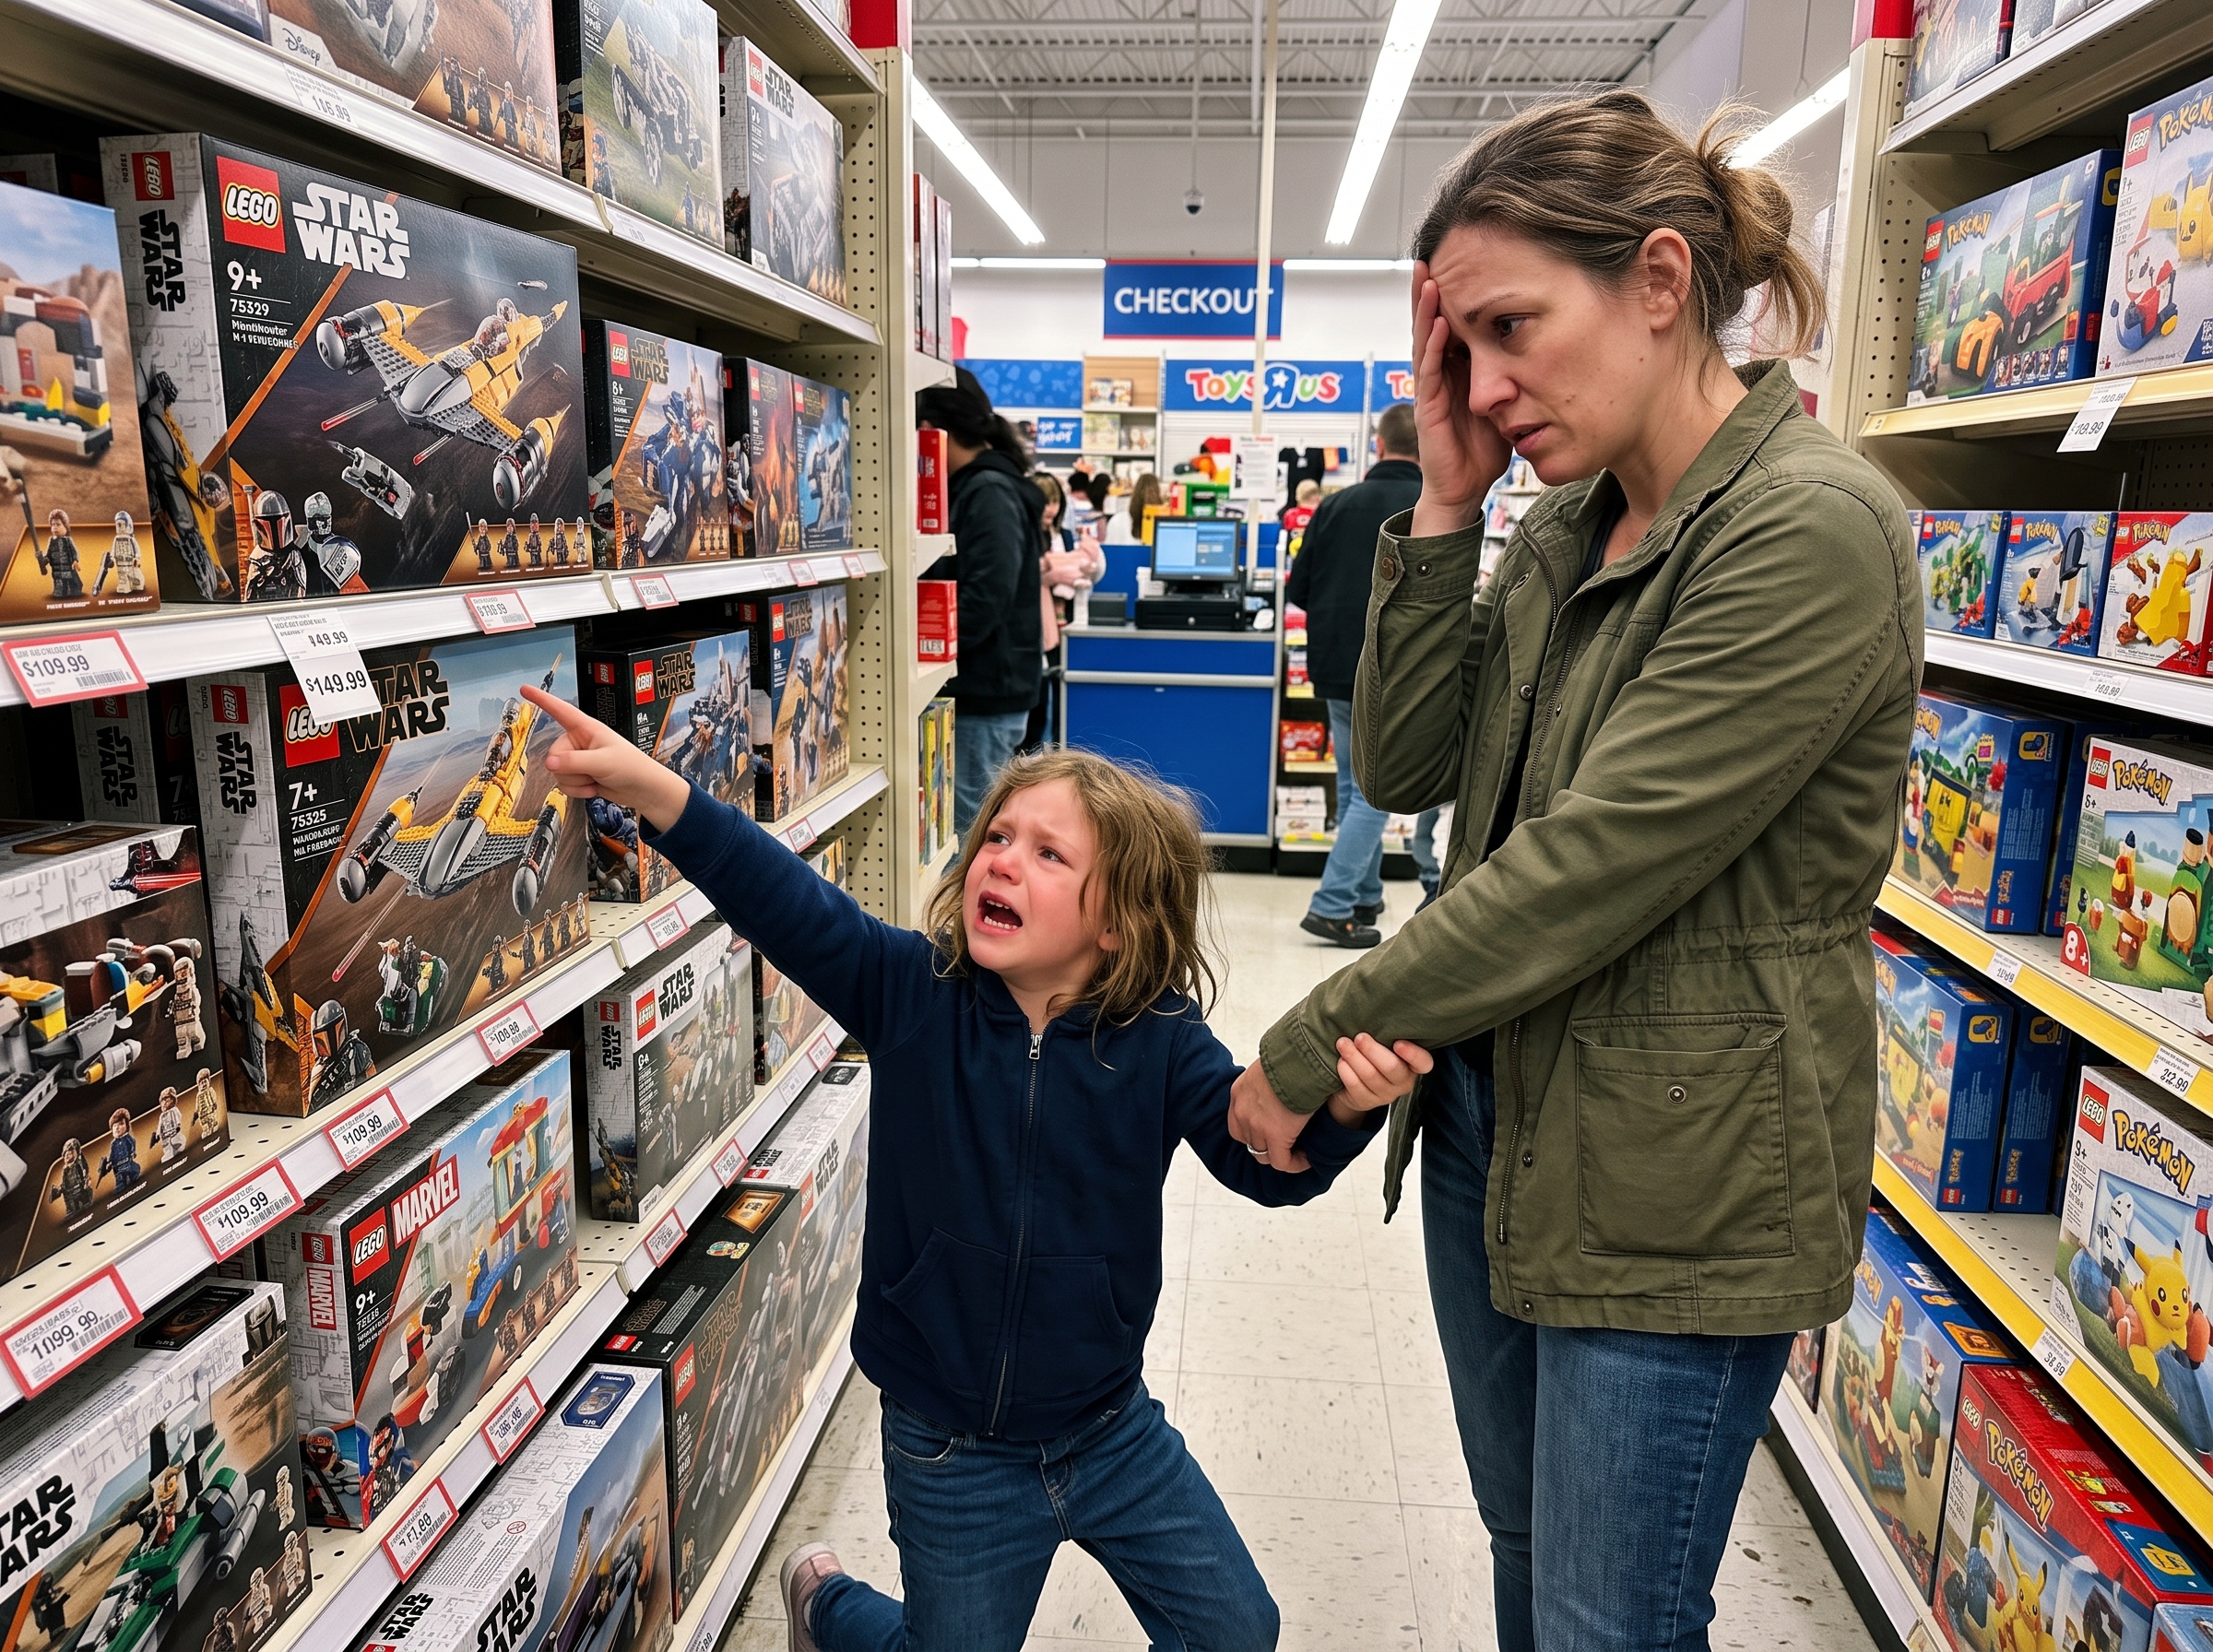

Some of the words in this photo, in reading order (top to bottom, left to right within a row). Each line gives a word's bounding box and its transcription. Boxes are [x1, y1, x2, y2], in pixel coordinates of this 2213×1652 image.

[223, 183, 280, 228] LEGO
[292, 182, 409, 244] STAR
[139, 210, 167, 312] WARS
[159, 209, 185, 312] STAR
[294, 218, 410, 279] WARS
[227, 260, 262, 290] 9+
[230, 298, 270, 316] 75329
[1114, 287, 1274, 314] CHECKOU
[22, 655, 90, 678] $109.99
[305, 669, 367, 696] $149.99
[368, 659, 449, 706] TAR
[346, 695, 451, 754] WARS
[96, 726, 122, 808] WARS
[113, 726, 138, 807] STAR
[215, 731, 240, 814] WARS
[231, 731, 257, 814] STAR
[289, 781, 318, 810] 7+
[290, 808, 327, 831] 75325
[2065, 929, 2089, 967] 8+
[658, 962, 694, 1005] STAR
[658, 978, 695, 1021] WARS
[393, 1162, 459, 1245] MARVEL
[352, 1224, 386, 1268] LEGO
[307, 1268, 336, 1327] MARVEL
[355, 1290, 376, 1316] 9+
[0, 1475, 75, 1552] AR
[0, 1494, 77, 1589] ARS
[379, 1592, 424, 1640] STAR
[388, 1593, 434, 1641] WARS
